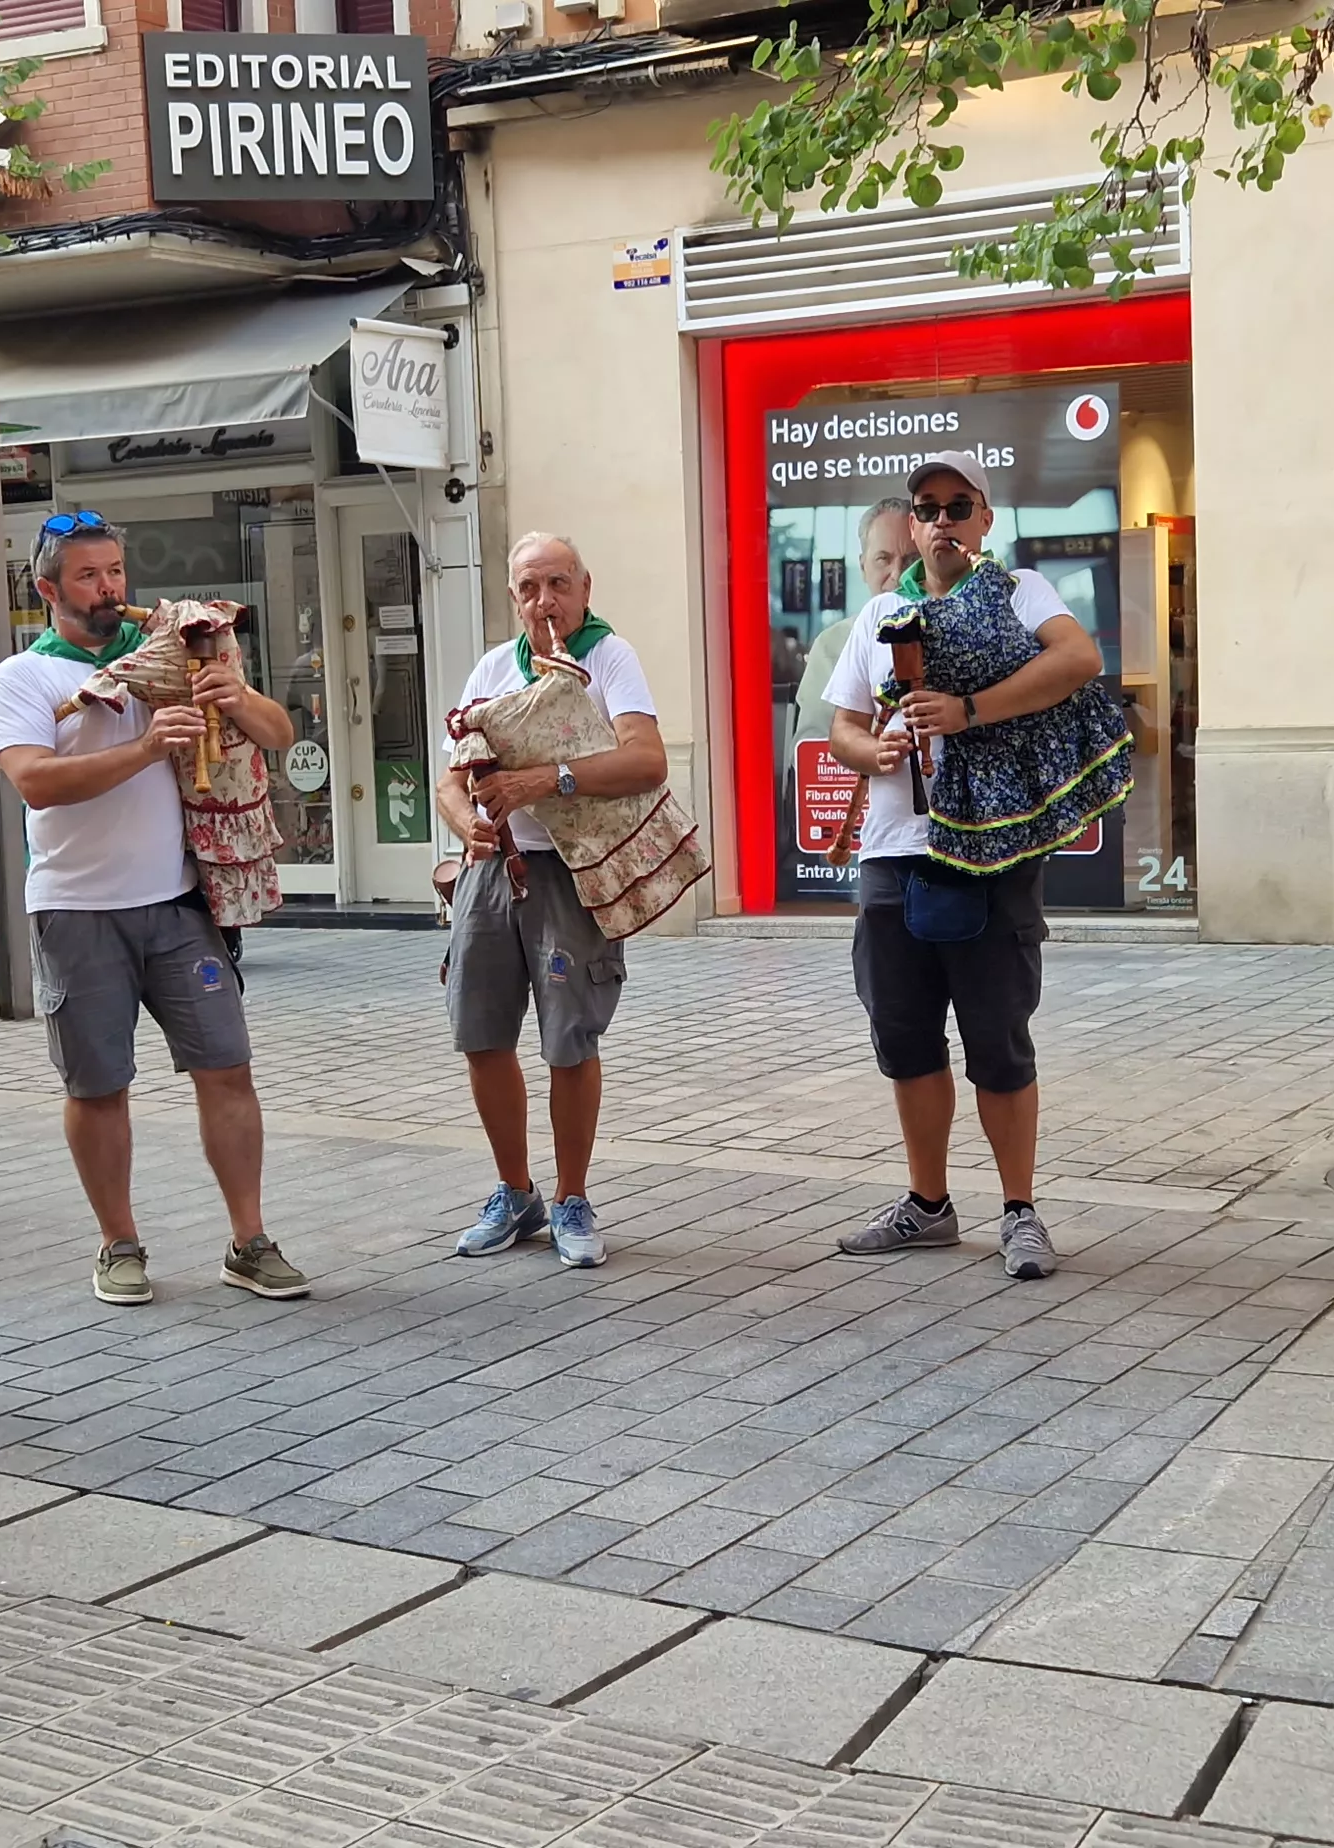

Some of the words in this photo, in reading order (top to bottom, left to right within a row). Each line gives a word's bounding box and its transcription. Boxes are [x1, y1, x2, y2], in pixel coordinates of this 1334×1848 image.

[164, 53, 411, 89] EDITORIAL
[168, 101, 414, 176] PIRINEO
[362, 338, 440, 397] Ana
[771, 418, 818, 448] Hay
[823, 410, 959, 440] decisiones
[772, 460, 817, 487] que
[824, 458, 852, 478] se
[290, 757, 324, 770] AA-J
[295, 746, 317, 756] CUP
[818, 752, 825, 763] 2
[805, 789, 831, 801] Fibra
[796, 863, 834, 879] Entra
[836, 867, 846, 882] y
[1138, 856, 1188, 891] 24
